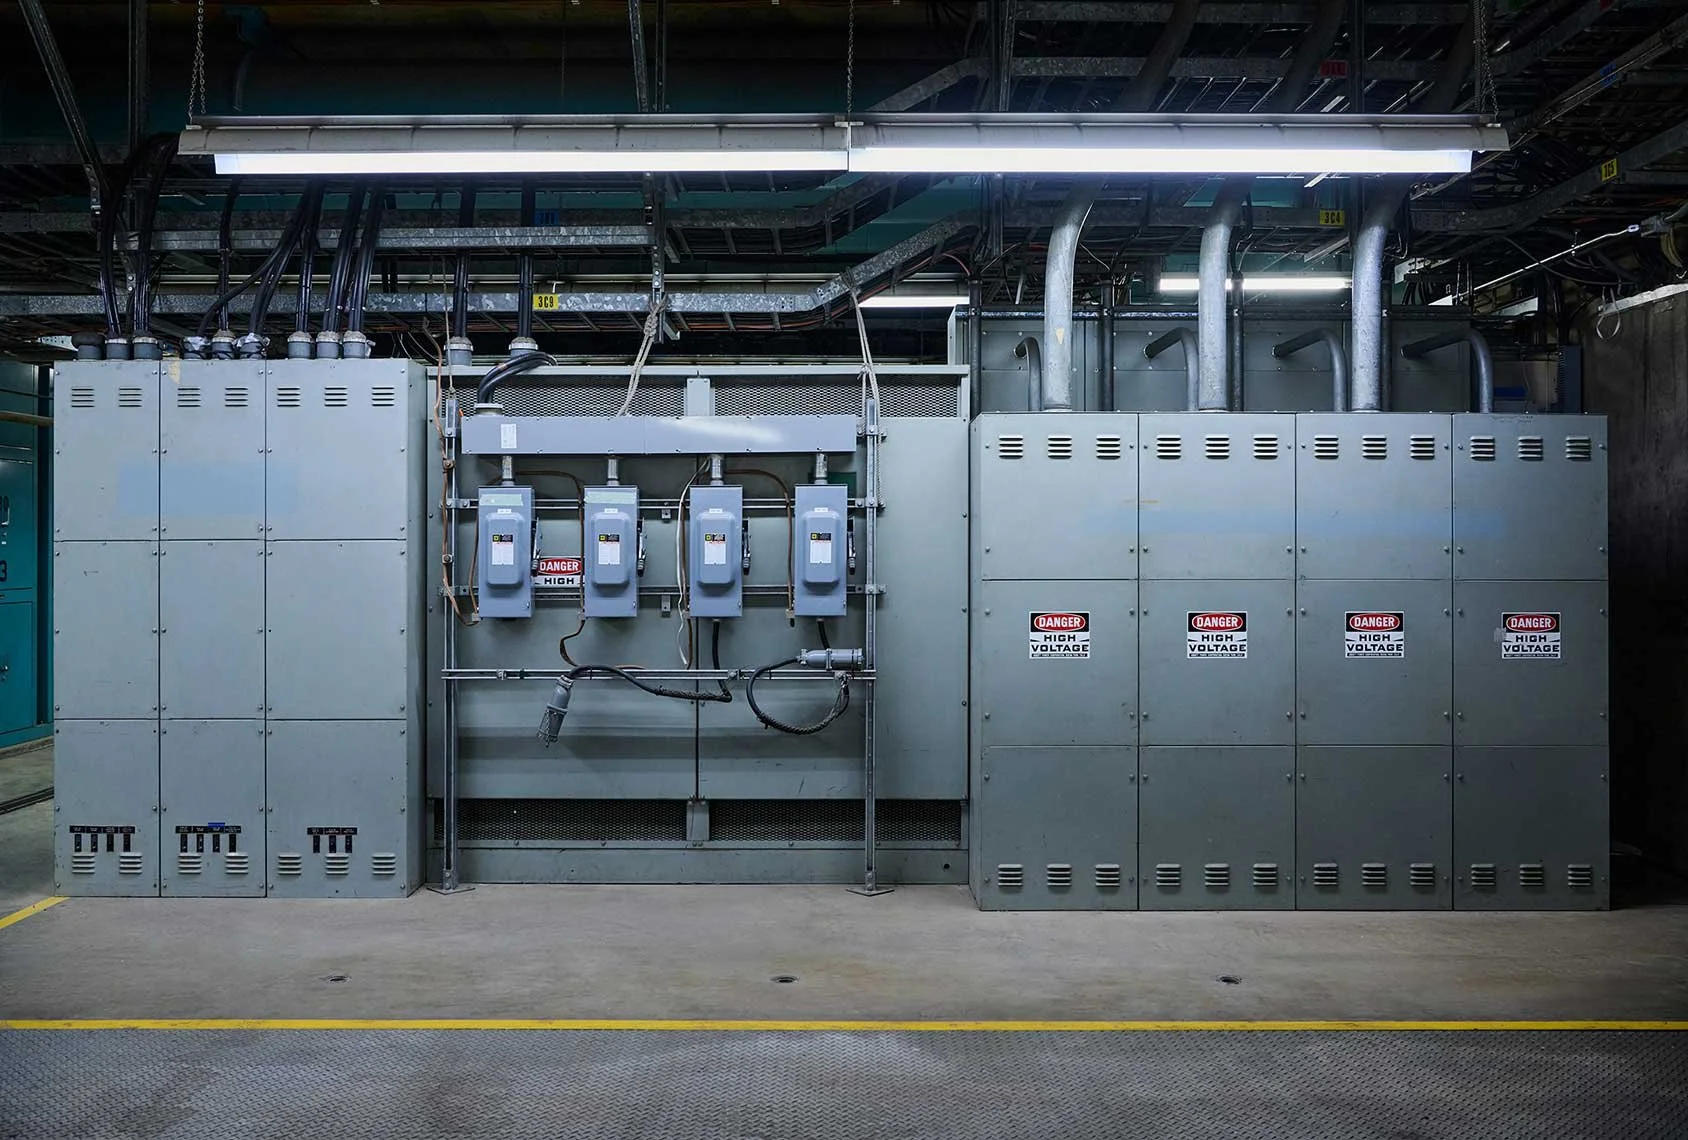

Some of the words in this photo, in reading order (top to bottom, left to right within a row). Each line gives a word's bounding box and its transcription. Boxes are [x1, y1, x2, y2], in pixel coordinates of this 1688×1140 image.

[538, 296, 554, 308] 3C9
[540, 561, 579, 571] DANGER
[544, 577, 574, 585] HIGH
[1039, 617, 1081, 627] DANGER
[1196, 617, 1239, 627] DANGER
[1354, 617, 1395, 627] DANGER
[1511, 618, 1552, 628] DANGER
[1044, 634, 1076, 642] HIGH
[1201, 634, 1233, 642] HIGH
[1359, 634, 1391, 642] HIGH
[1515, 635, 1547, 643] HIGH
[1031, 644, 1089, 652] VOLTAGE
[1189, 644, 1247, 652] VOLTAGE
[1346, 643, 1403, 651] VOLTAGE
[1503, 644, 1560, 652] VOLTAGE
